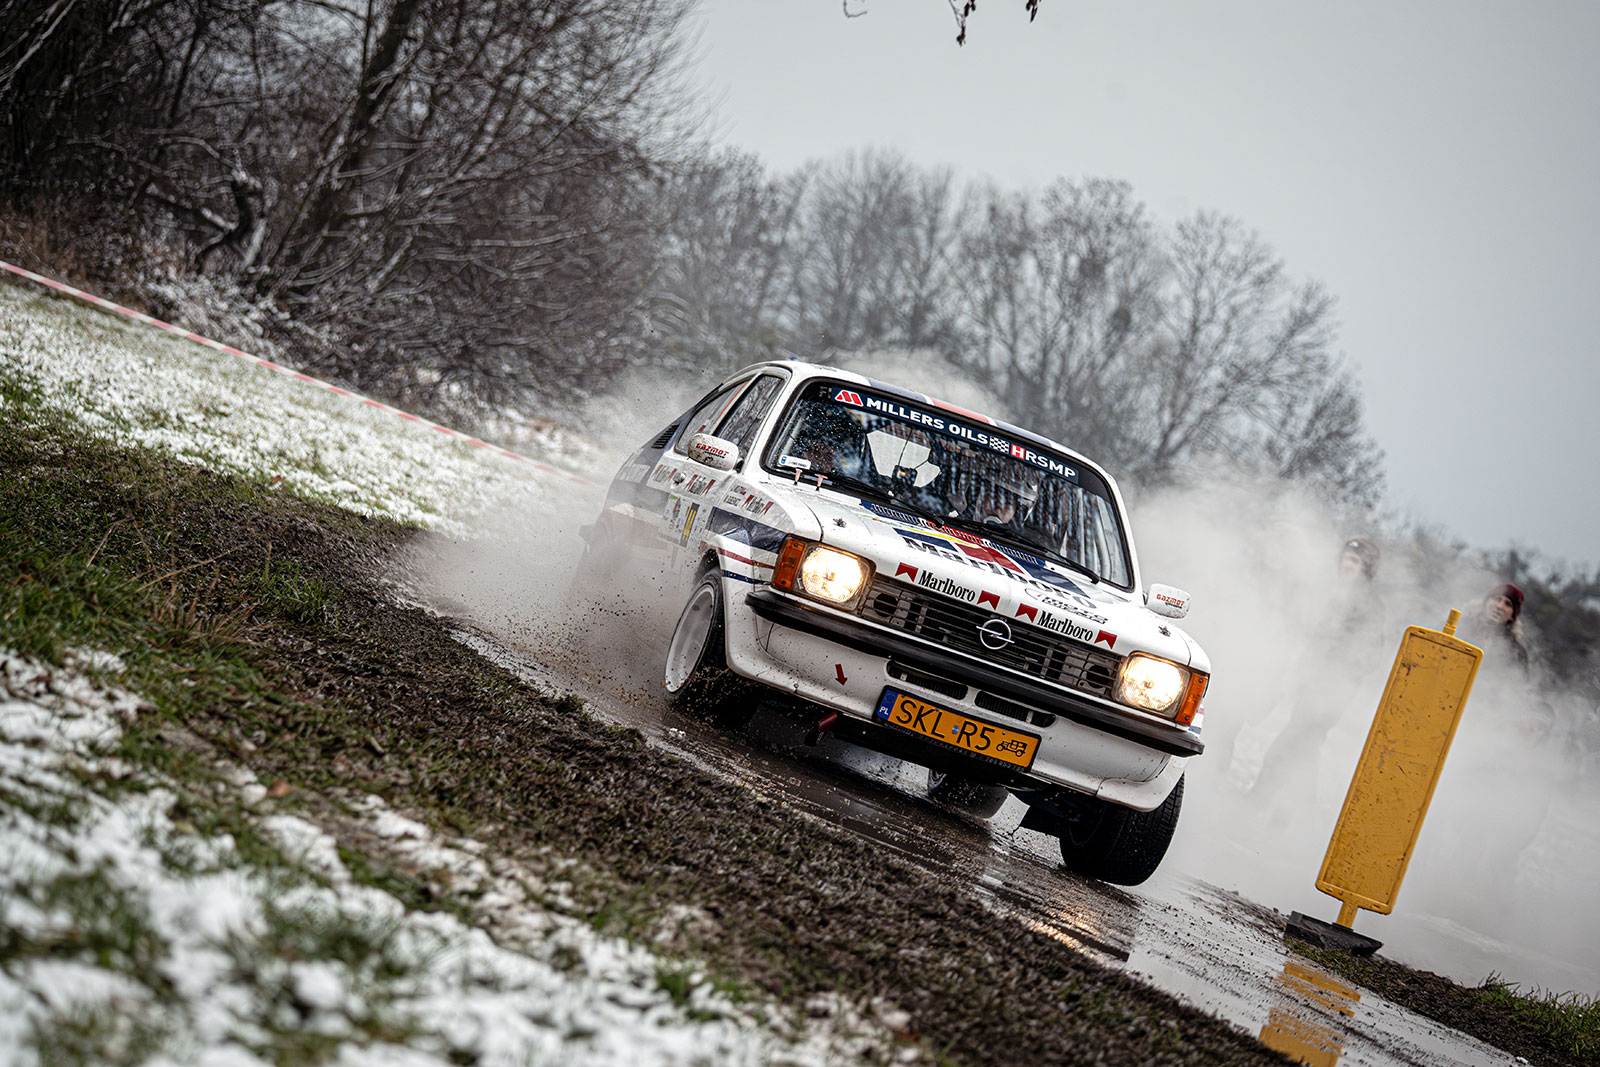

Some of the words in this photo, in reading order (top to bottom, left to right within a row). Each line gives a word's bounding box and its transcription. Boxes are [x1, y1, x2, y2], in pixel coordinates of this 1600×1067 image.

[866, 398, 945, 430] MILLERS
[949, 424, 988, 445] OILS
[903, 537, 1097, 609] Marlboro
[918, 569, 976, 602] Marlboro
[1037, 609, 1093, 642] Marlboro
[879, 706, 889, 716] PL
[896, 699, 945, 739] SKL
[956, 720, 995, 751] R5
